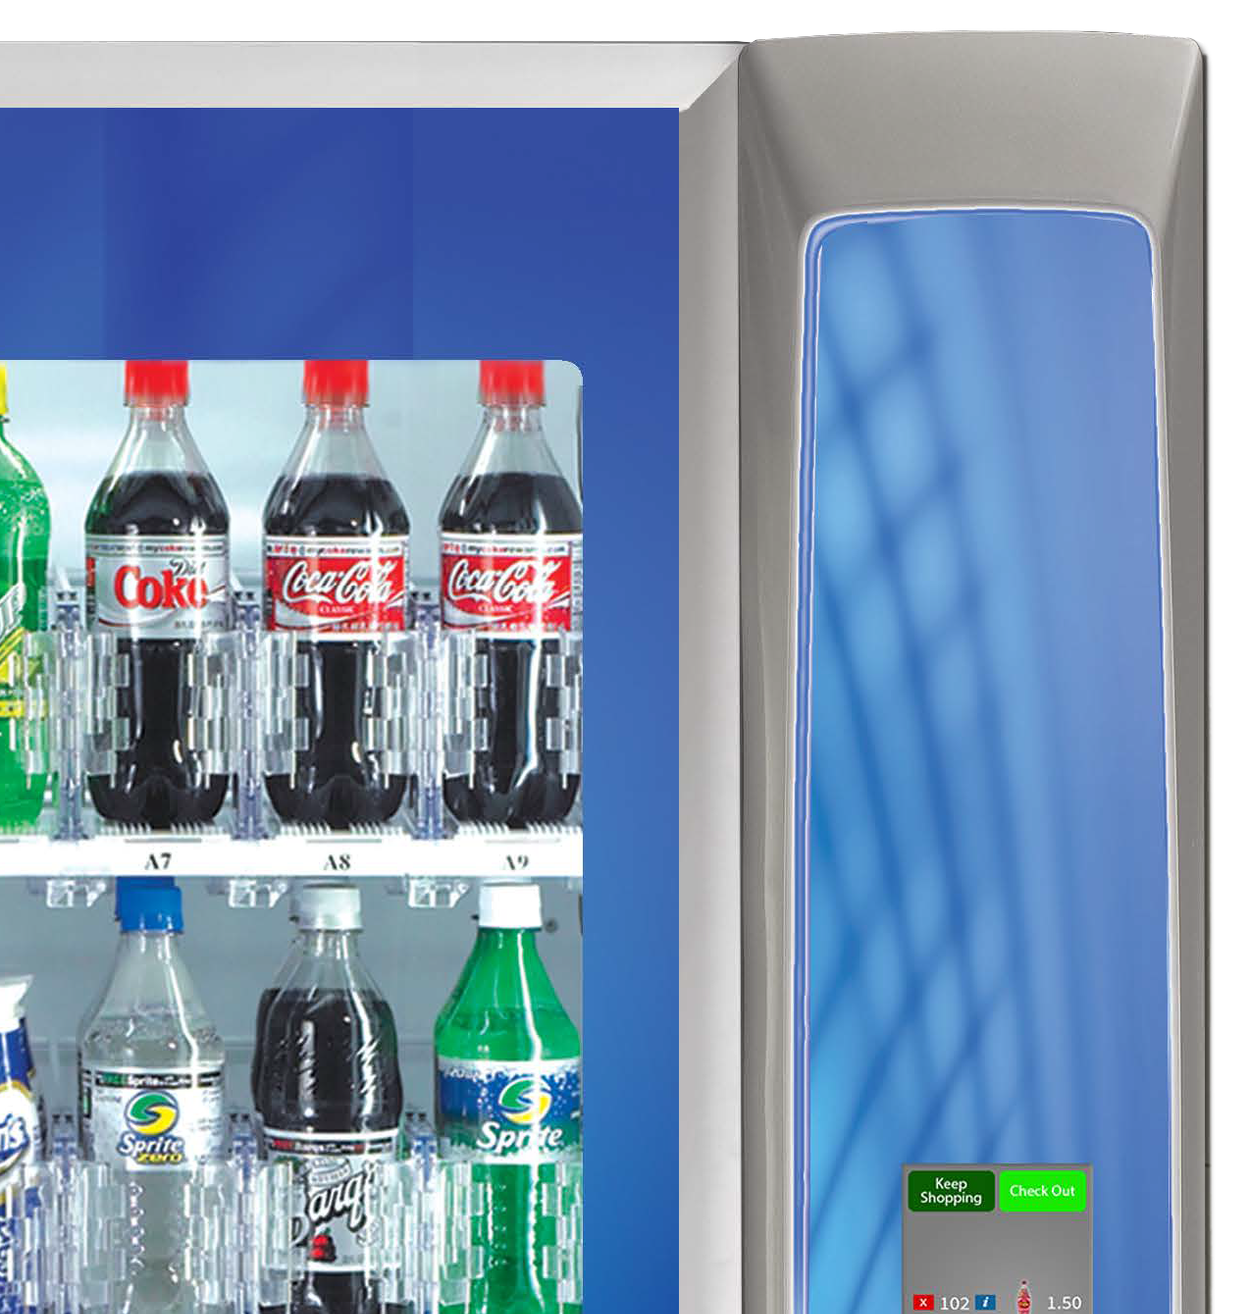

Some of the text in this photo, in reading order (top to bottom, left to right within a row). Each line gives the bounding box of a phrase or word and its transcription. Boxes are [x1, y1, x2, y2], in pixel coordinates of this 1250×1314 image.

[114, 564, 209, 610] Coke
[283, 559, 400, 604] Coca-Cola
[145, 853, 172, 871] A7
[324, 854, 351, 871] A8
[505, 854, 530, 871] A9
[119, 1132, 184, 1157] Sprite
[136, 1151, 183, 1163] zero
[936, 1178, 967, 1194] Keep
[1009, 1185, 1076, 1198] Check Out
[920, 1192, 982, 1206] Shopping
[940, 1296, 970, 1311] 102
[1047, 1296, 1082, 1311] 1.50
